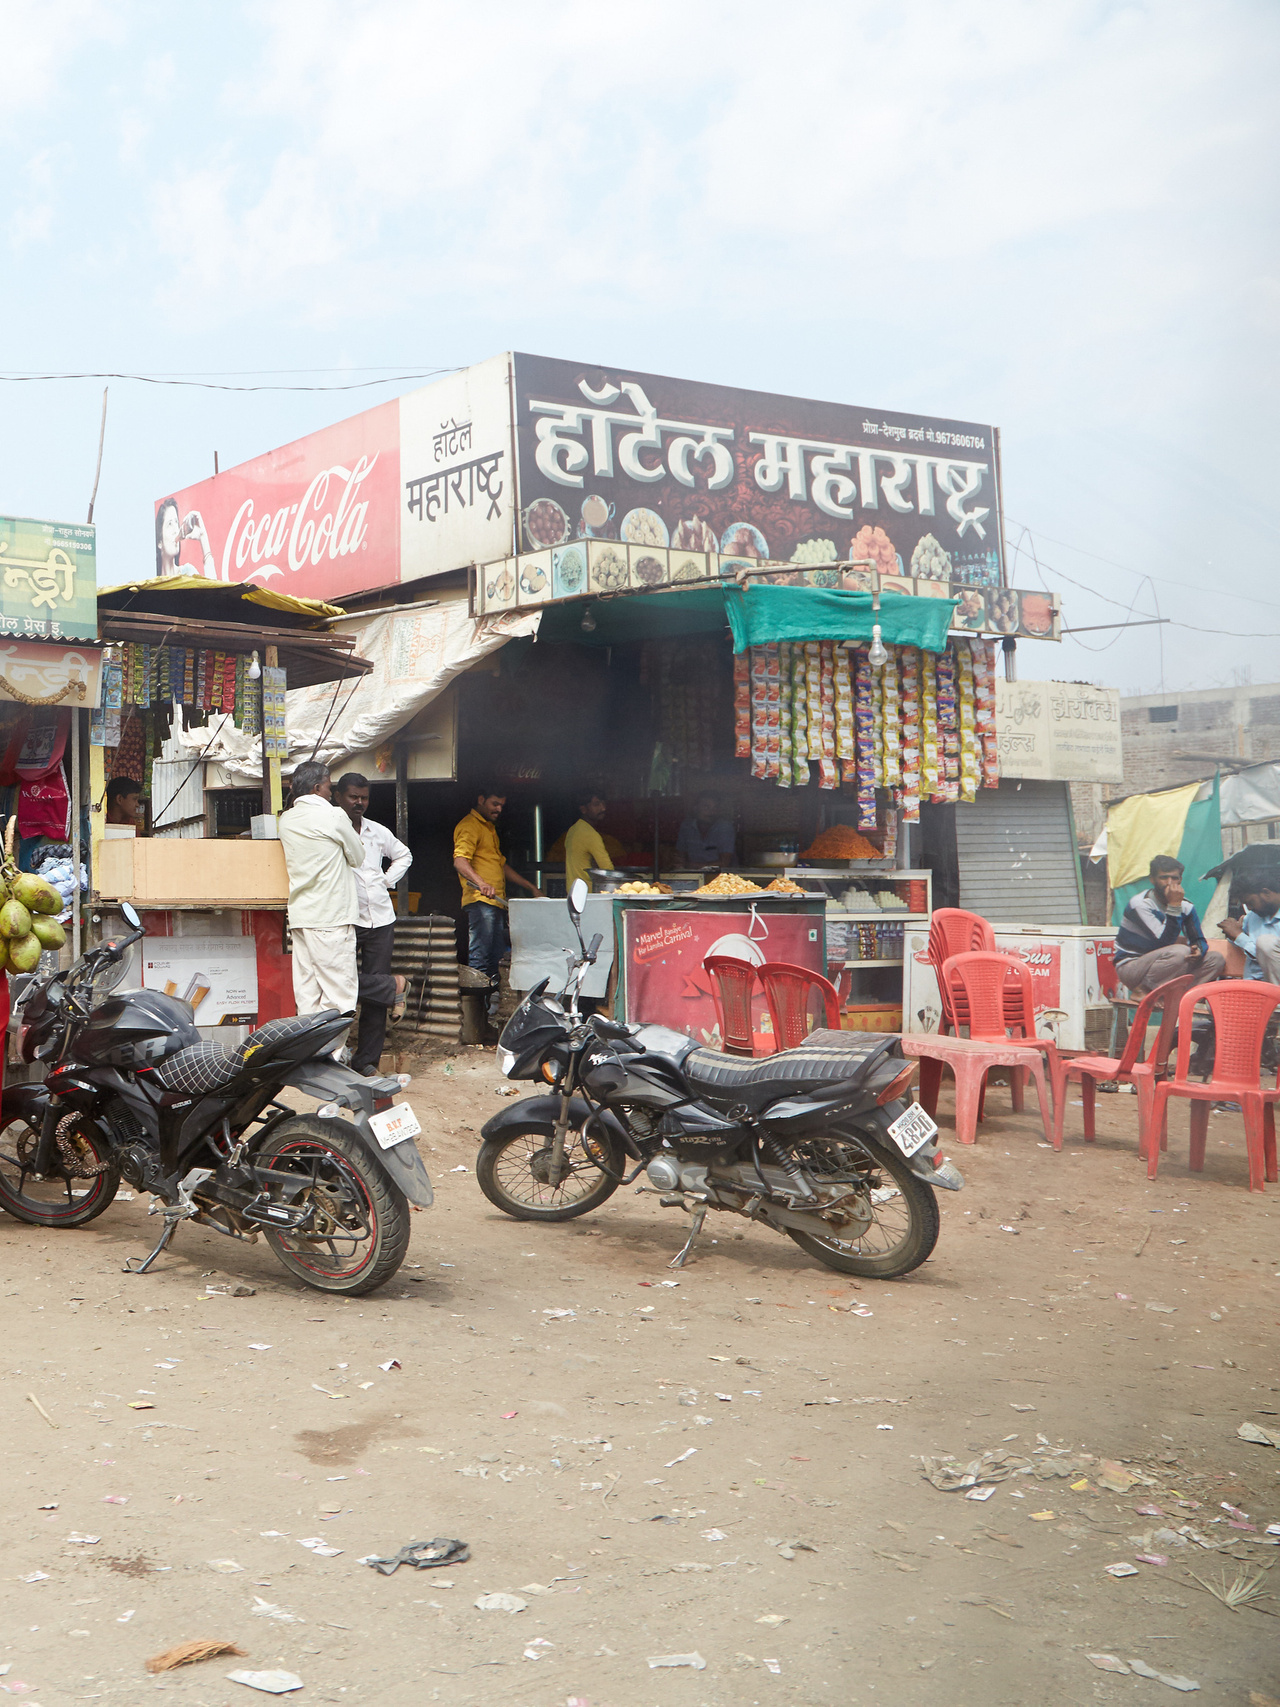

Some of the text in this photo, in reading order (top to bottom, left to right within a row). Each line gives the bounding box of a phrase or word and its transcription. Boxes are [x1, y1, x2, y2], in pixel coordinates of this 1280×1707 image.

[433, 418, 472, 463] हॉटेल
[529, 379, 990, 541] हॉटेल महाराष्ट्र
[406, 450, 504, 523] महाराष्ट्र
[222, 450, 380, 583] Coca-Cola
[24, 615, 47, 633] प्रेस
[640, 927, 664, 945] Marvel
[664, 926, 693, 945] Carnival
[1019, 943, 1053, 966] Sun
